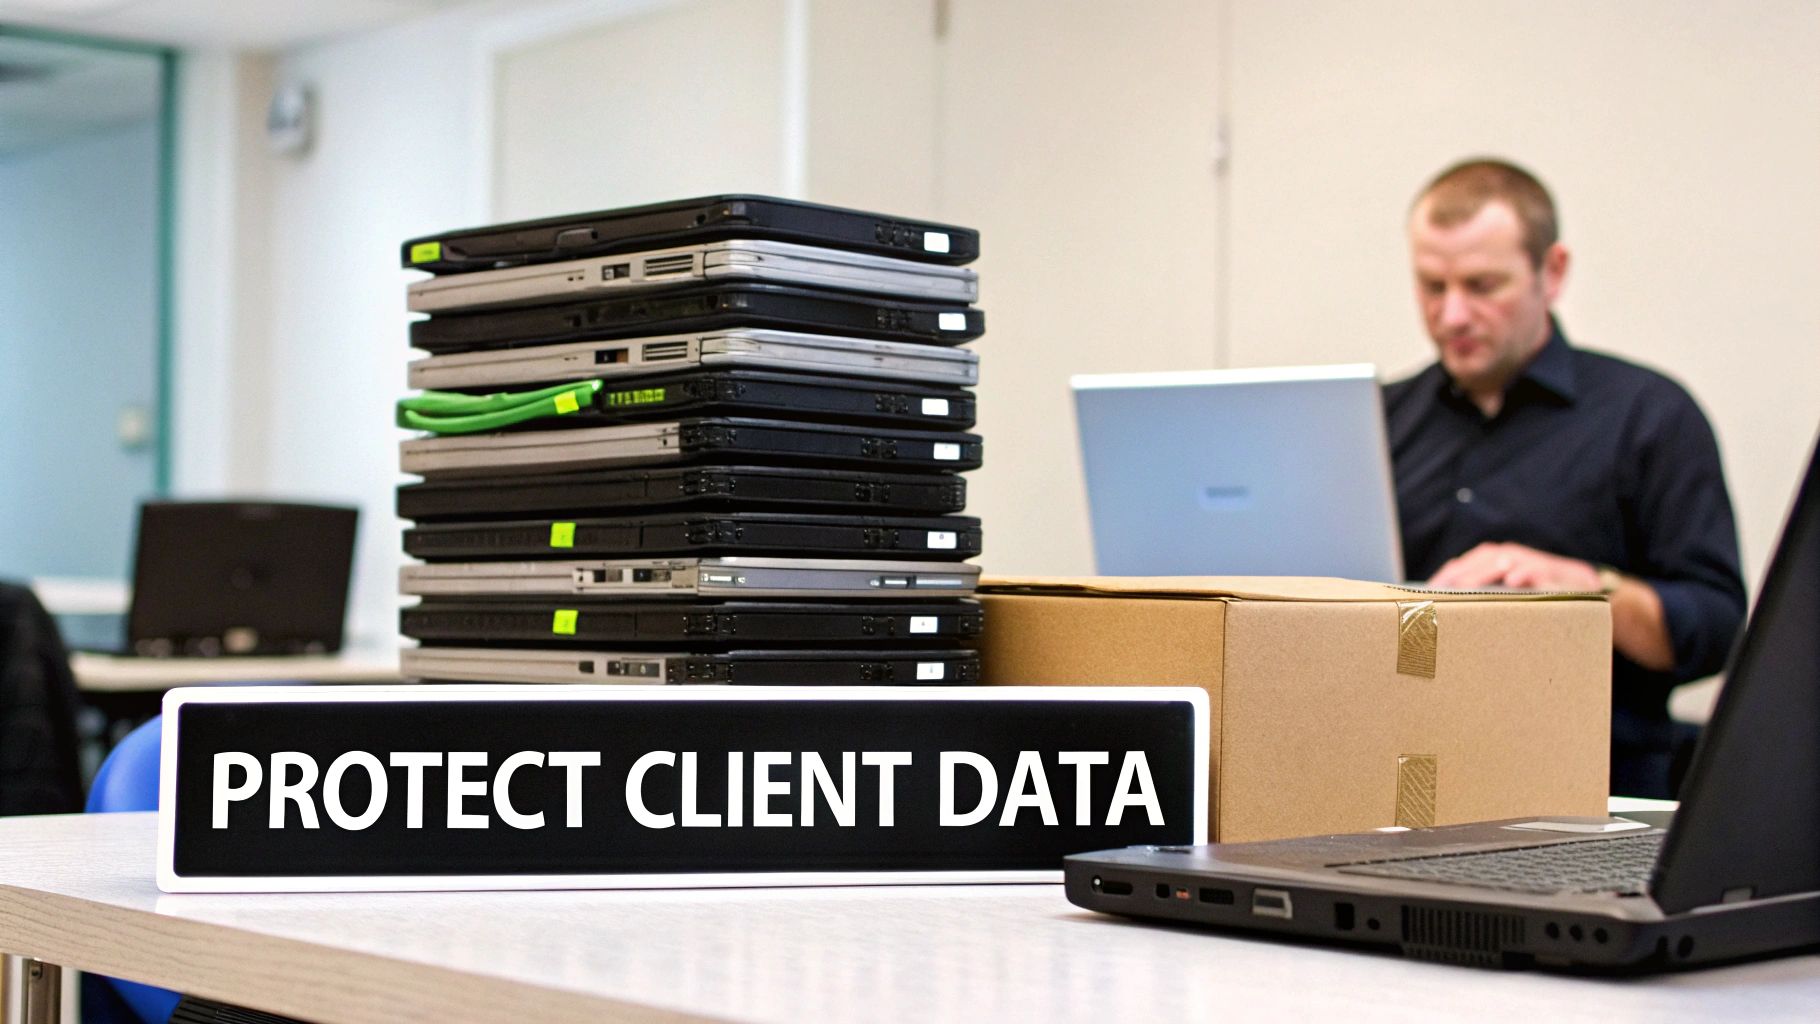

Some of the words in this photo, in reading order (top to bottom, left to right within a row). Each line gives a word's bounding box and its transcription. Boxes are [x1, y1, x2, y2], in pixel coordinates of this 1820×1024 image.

[212, 751, 600, 830] PROTECT
[626, 751, 912, 828] CLIENT
[940, 751, 1165, 827] DATA
